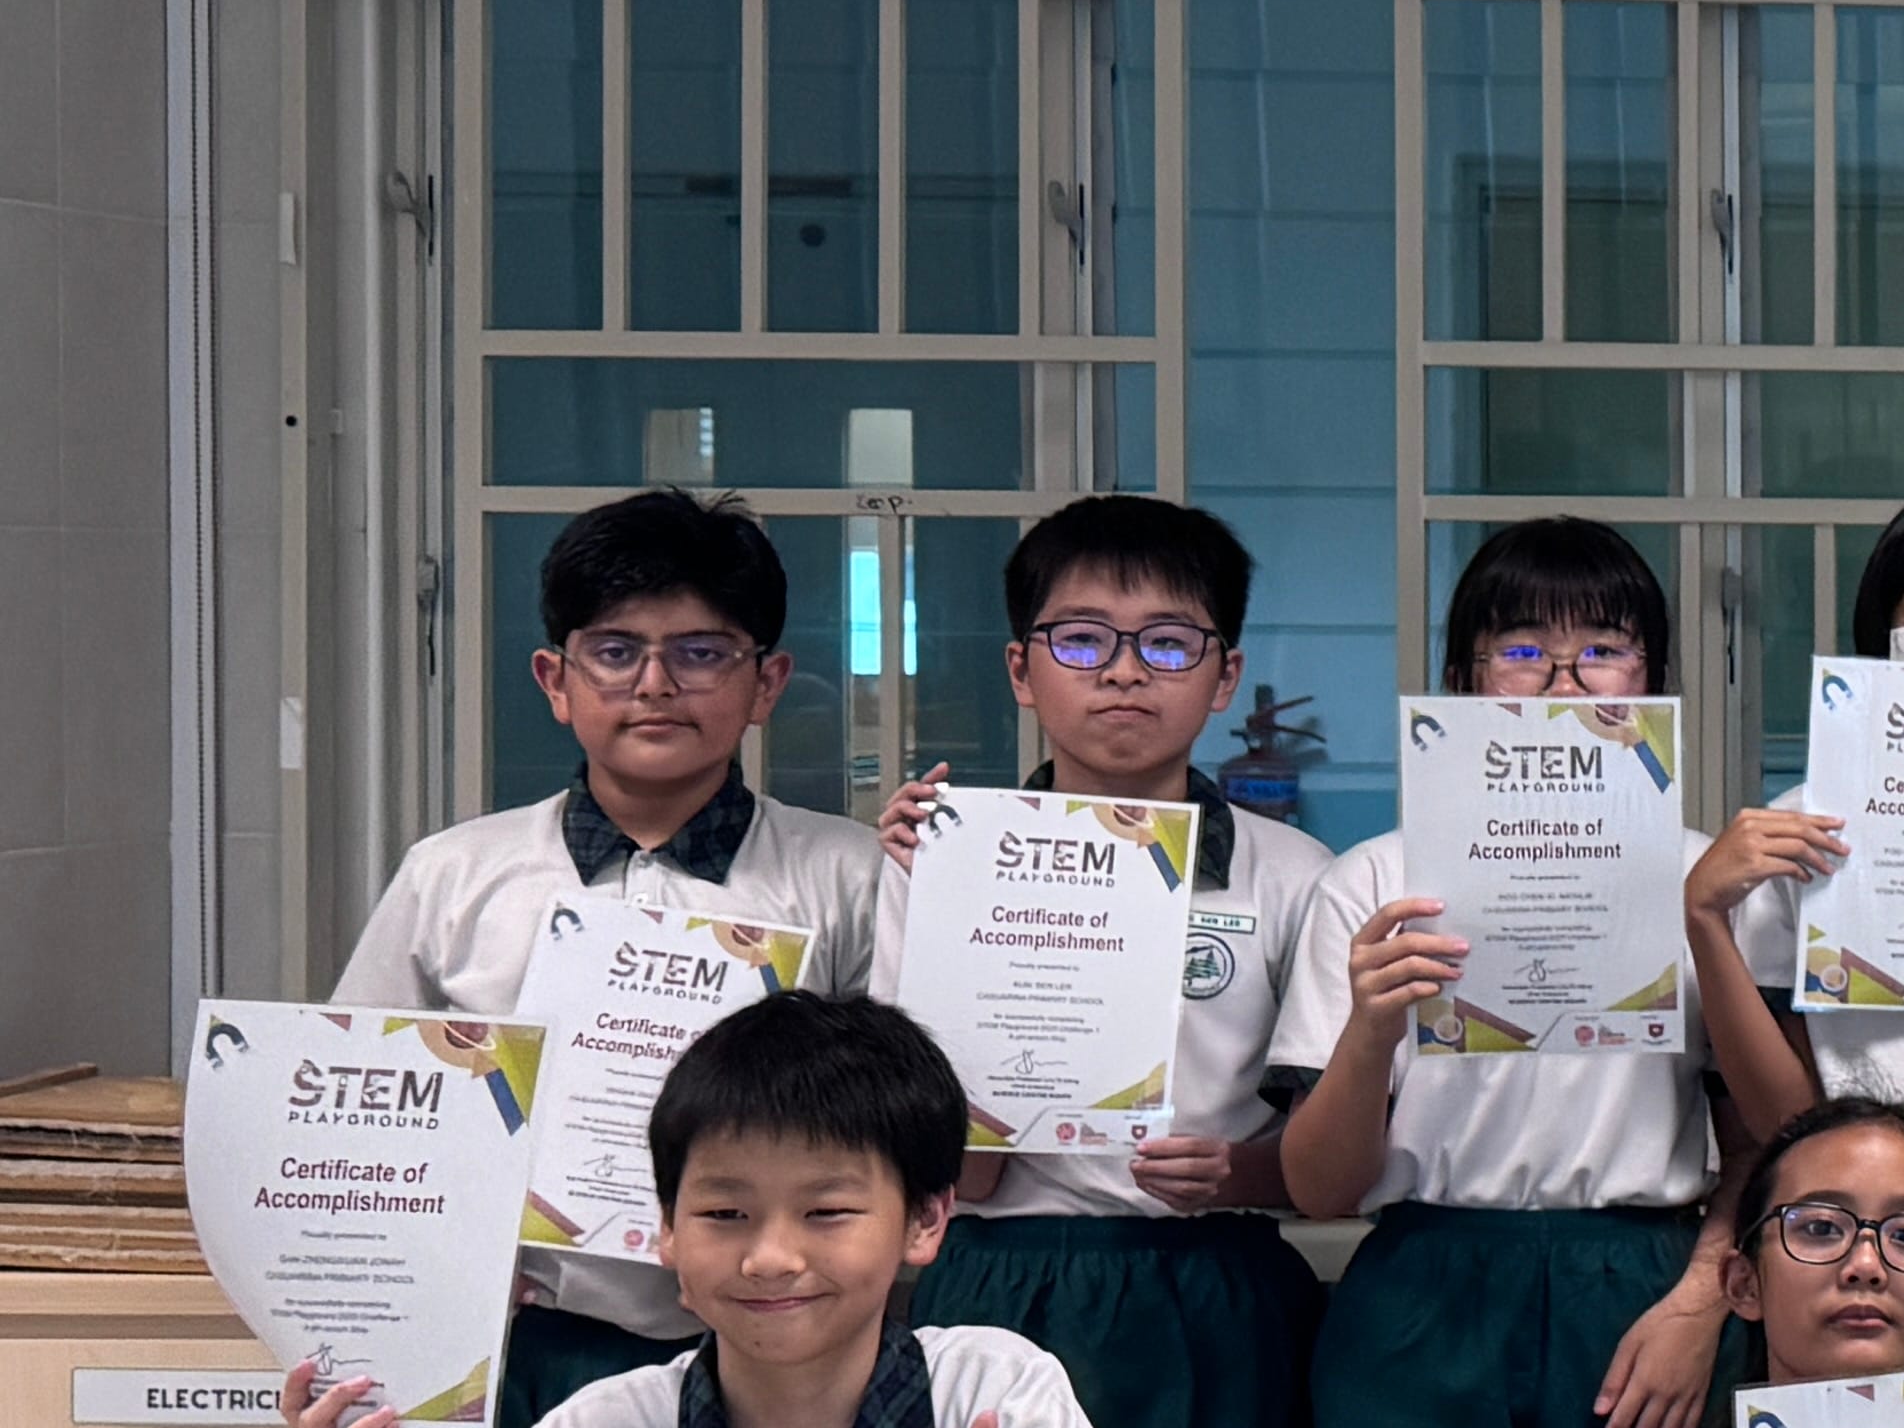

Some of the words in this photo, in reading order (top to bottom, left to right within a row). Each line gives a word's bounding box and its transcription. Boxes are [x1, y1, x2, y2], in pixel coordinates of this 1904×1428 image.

[1484, 740, 1603, 779] STEM
[1487, 783, 1605, 793] PLAYGROUND
[1487, 819, 1579, 836] Certificate
[1585, 818, 1603, 836] of
[995, 830, 1115, 875] STEM
[1468, 842, 1622, 863] Accomplishment
[996, 871, 1115, 888] PLAYGROUND
[991, 905, 1084, 928] Certificate
[1090, 911, 1109, 929] of
[970, 928, 1124, 952] Accomplishment
[608, 941, 729, 992] STEM
[607, 979, 723, 1005] PLAYGROUND
[571, 1031, 678, 1061] Accomplish
[690, 1030, 702, 1043] o
[288, 1059, 444, 1112] STEM
[288, 1110, 439, 1130] PLAYGROUND
[280, 1157, 396, 1184] Certificate
[402, 1162, 429, 1184] of
[254, 1187, 446, 1215] Accomplishment
[147, 1388, 280, 1410] ELECTRICI
